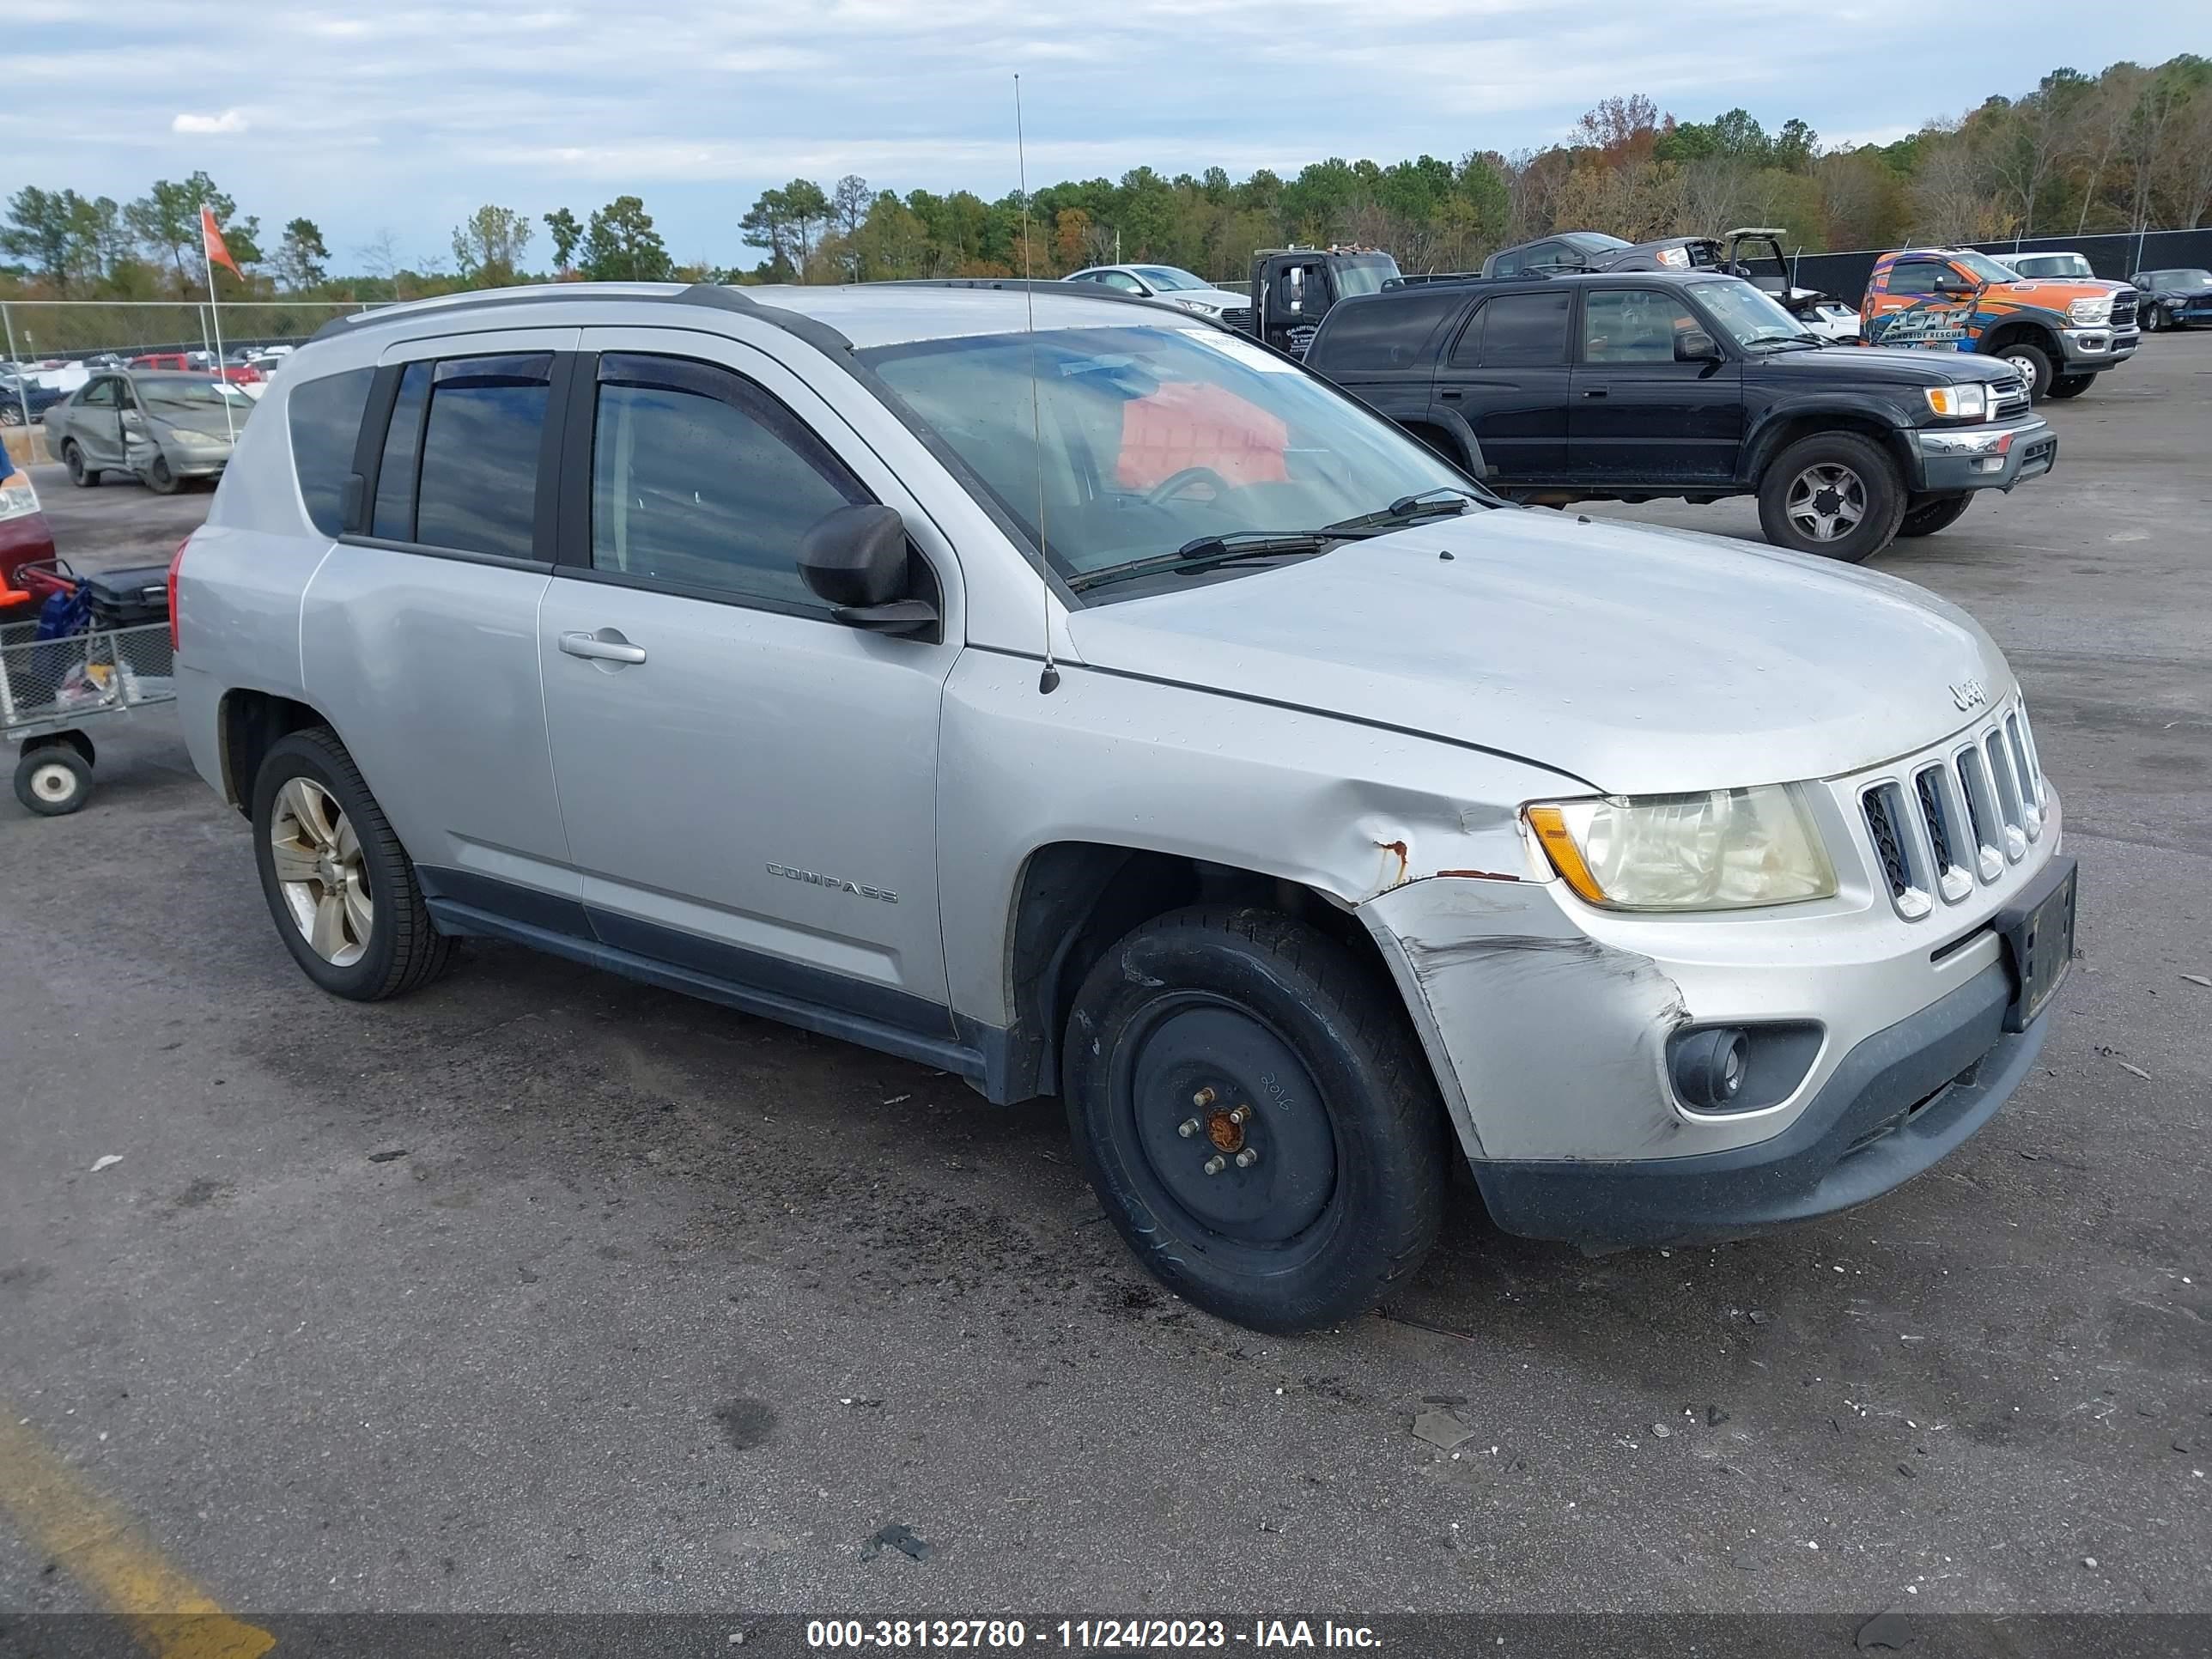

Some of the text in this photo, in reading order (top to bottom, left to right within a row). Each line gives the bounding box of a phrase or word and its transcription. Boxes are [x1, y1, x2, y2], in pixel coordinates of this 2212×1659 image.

[1886, 309, 1968, 331] ASAP
[1948, 679, 1986, 712] Jeep
[766, 860, 898, 903] COMPASS
